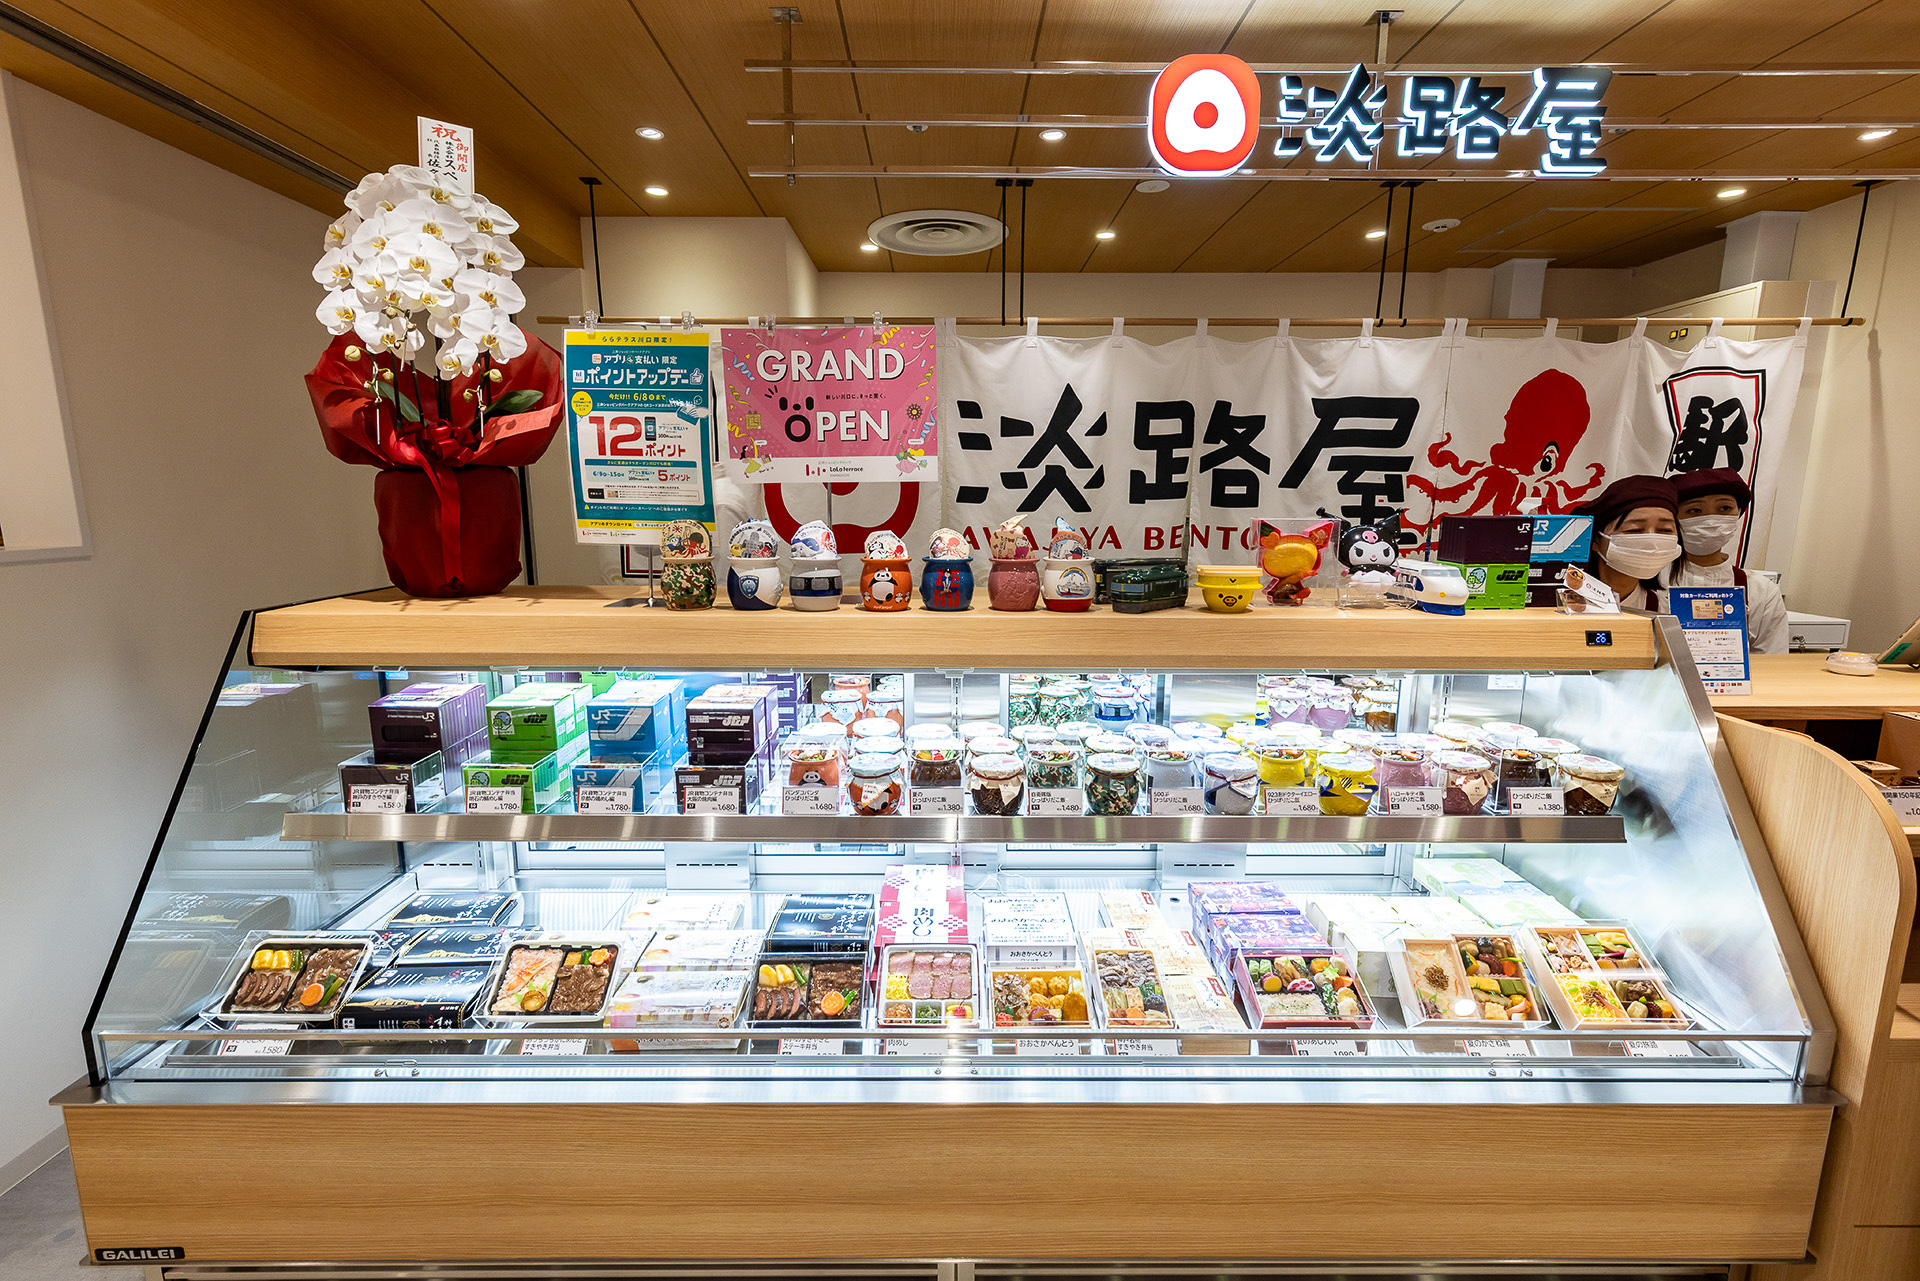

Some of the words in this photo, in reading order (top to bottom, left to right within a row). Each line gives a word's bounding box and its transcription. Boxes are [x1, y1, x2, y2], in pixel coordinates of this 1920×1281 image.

[1272, 62, 1614, 177] 淡路屋
[431, 123, 462, 142] 祝
[661, 355, 678, 365] 限定
[757, 348, 905, 382] GRAND
[785, 410, 890, 443] OPEN
[588, 416, 644, 456] 12
[645, 442, 686, 457] ポイント
[956, 383, 1420, 545] 淡路屋
[657, 469, 668, 482] 5
[668, 473, 691, 482] ポイント
[1518, 523, 1531, 531] JR
[1533, 520, 1550, 531] JR
[1595, 632, 1607, 644] 26
[421, 712, 435, 720] JR
[591, 709, 611, 721] JR
[395, 773, 410, 781] JR
[576, 771, 598, 782] JR
[1018, 1039, 1075, 1048] おおさかべんとう
[102, 1249, 175, 1260] GALILEI
